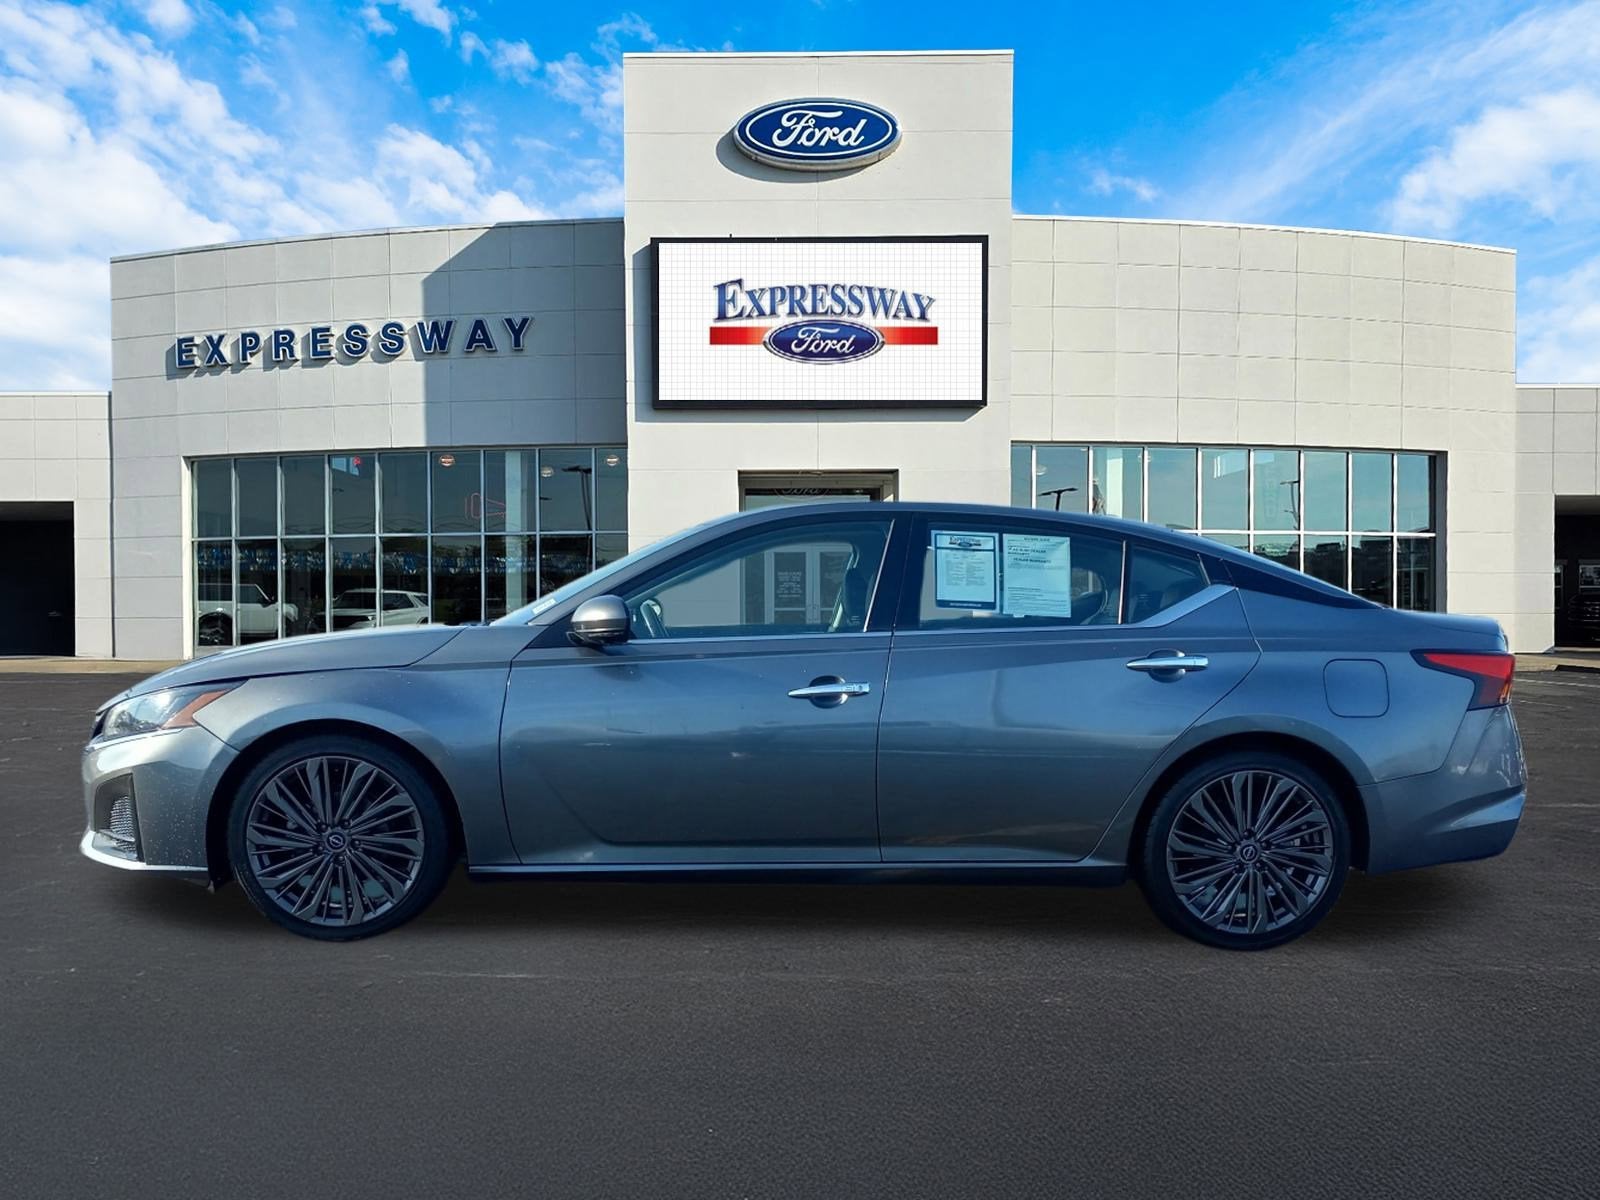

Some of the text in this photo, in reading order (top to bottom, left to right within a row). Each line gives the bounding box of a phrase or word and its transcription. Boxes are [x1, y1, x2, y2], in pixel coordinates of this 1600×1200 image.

[772, 109, 866, 147] Ford
[713, 278, 936, 323] EXPRESSWAY
[175, 315, 533, 369] EXPRESSWAY
[791, 327, 855, 354] Ford
